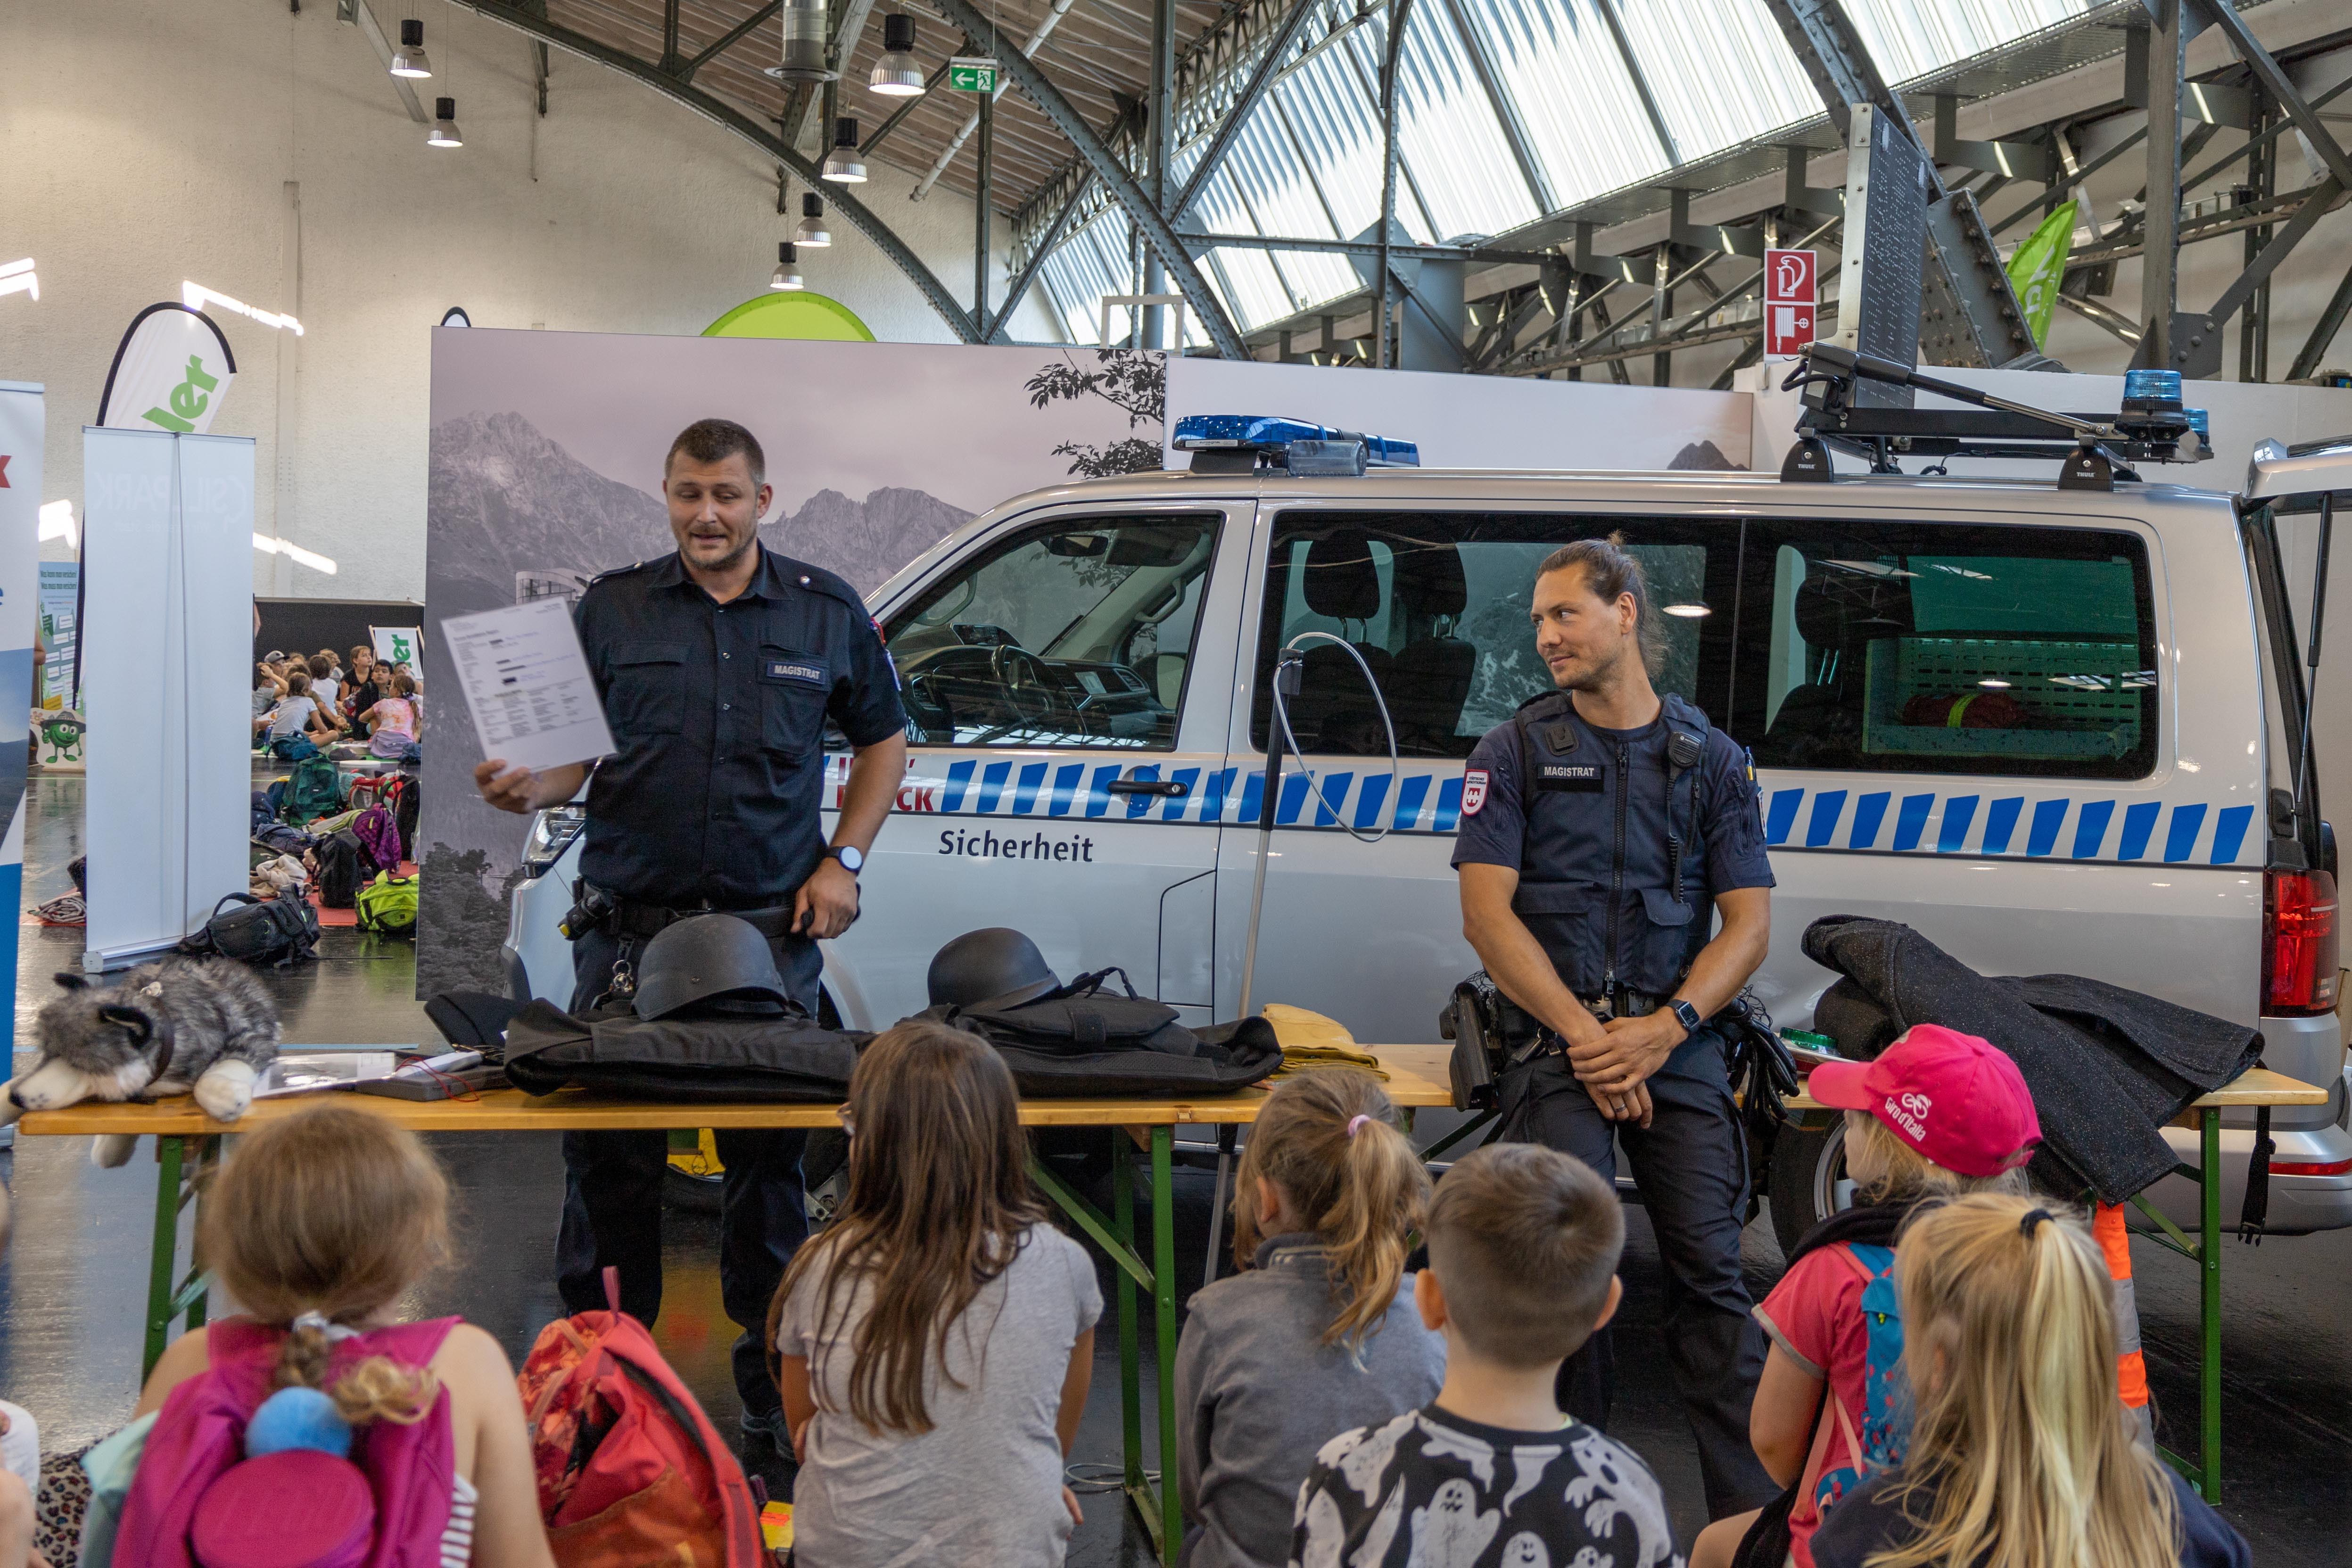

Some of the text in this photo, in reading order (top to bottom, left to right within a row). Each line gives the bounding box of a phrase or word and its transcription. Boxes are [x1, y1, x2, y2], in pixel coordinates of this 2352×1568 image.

[774, 665, 820, 679] MAGISTRAT
[1544, 767, 1594, 777] MAGISTRAT
[938, 828, 1094, 862] Sicherheit
[1885, 1097, 1901, 1119] Giro
